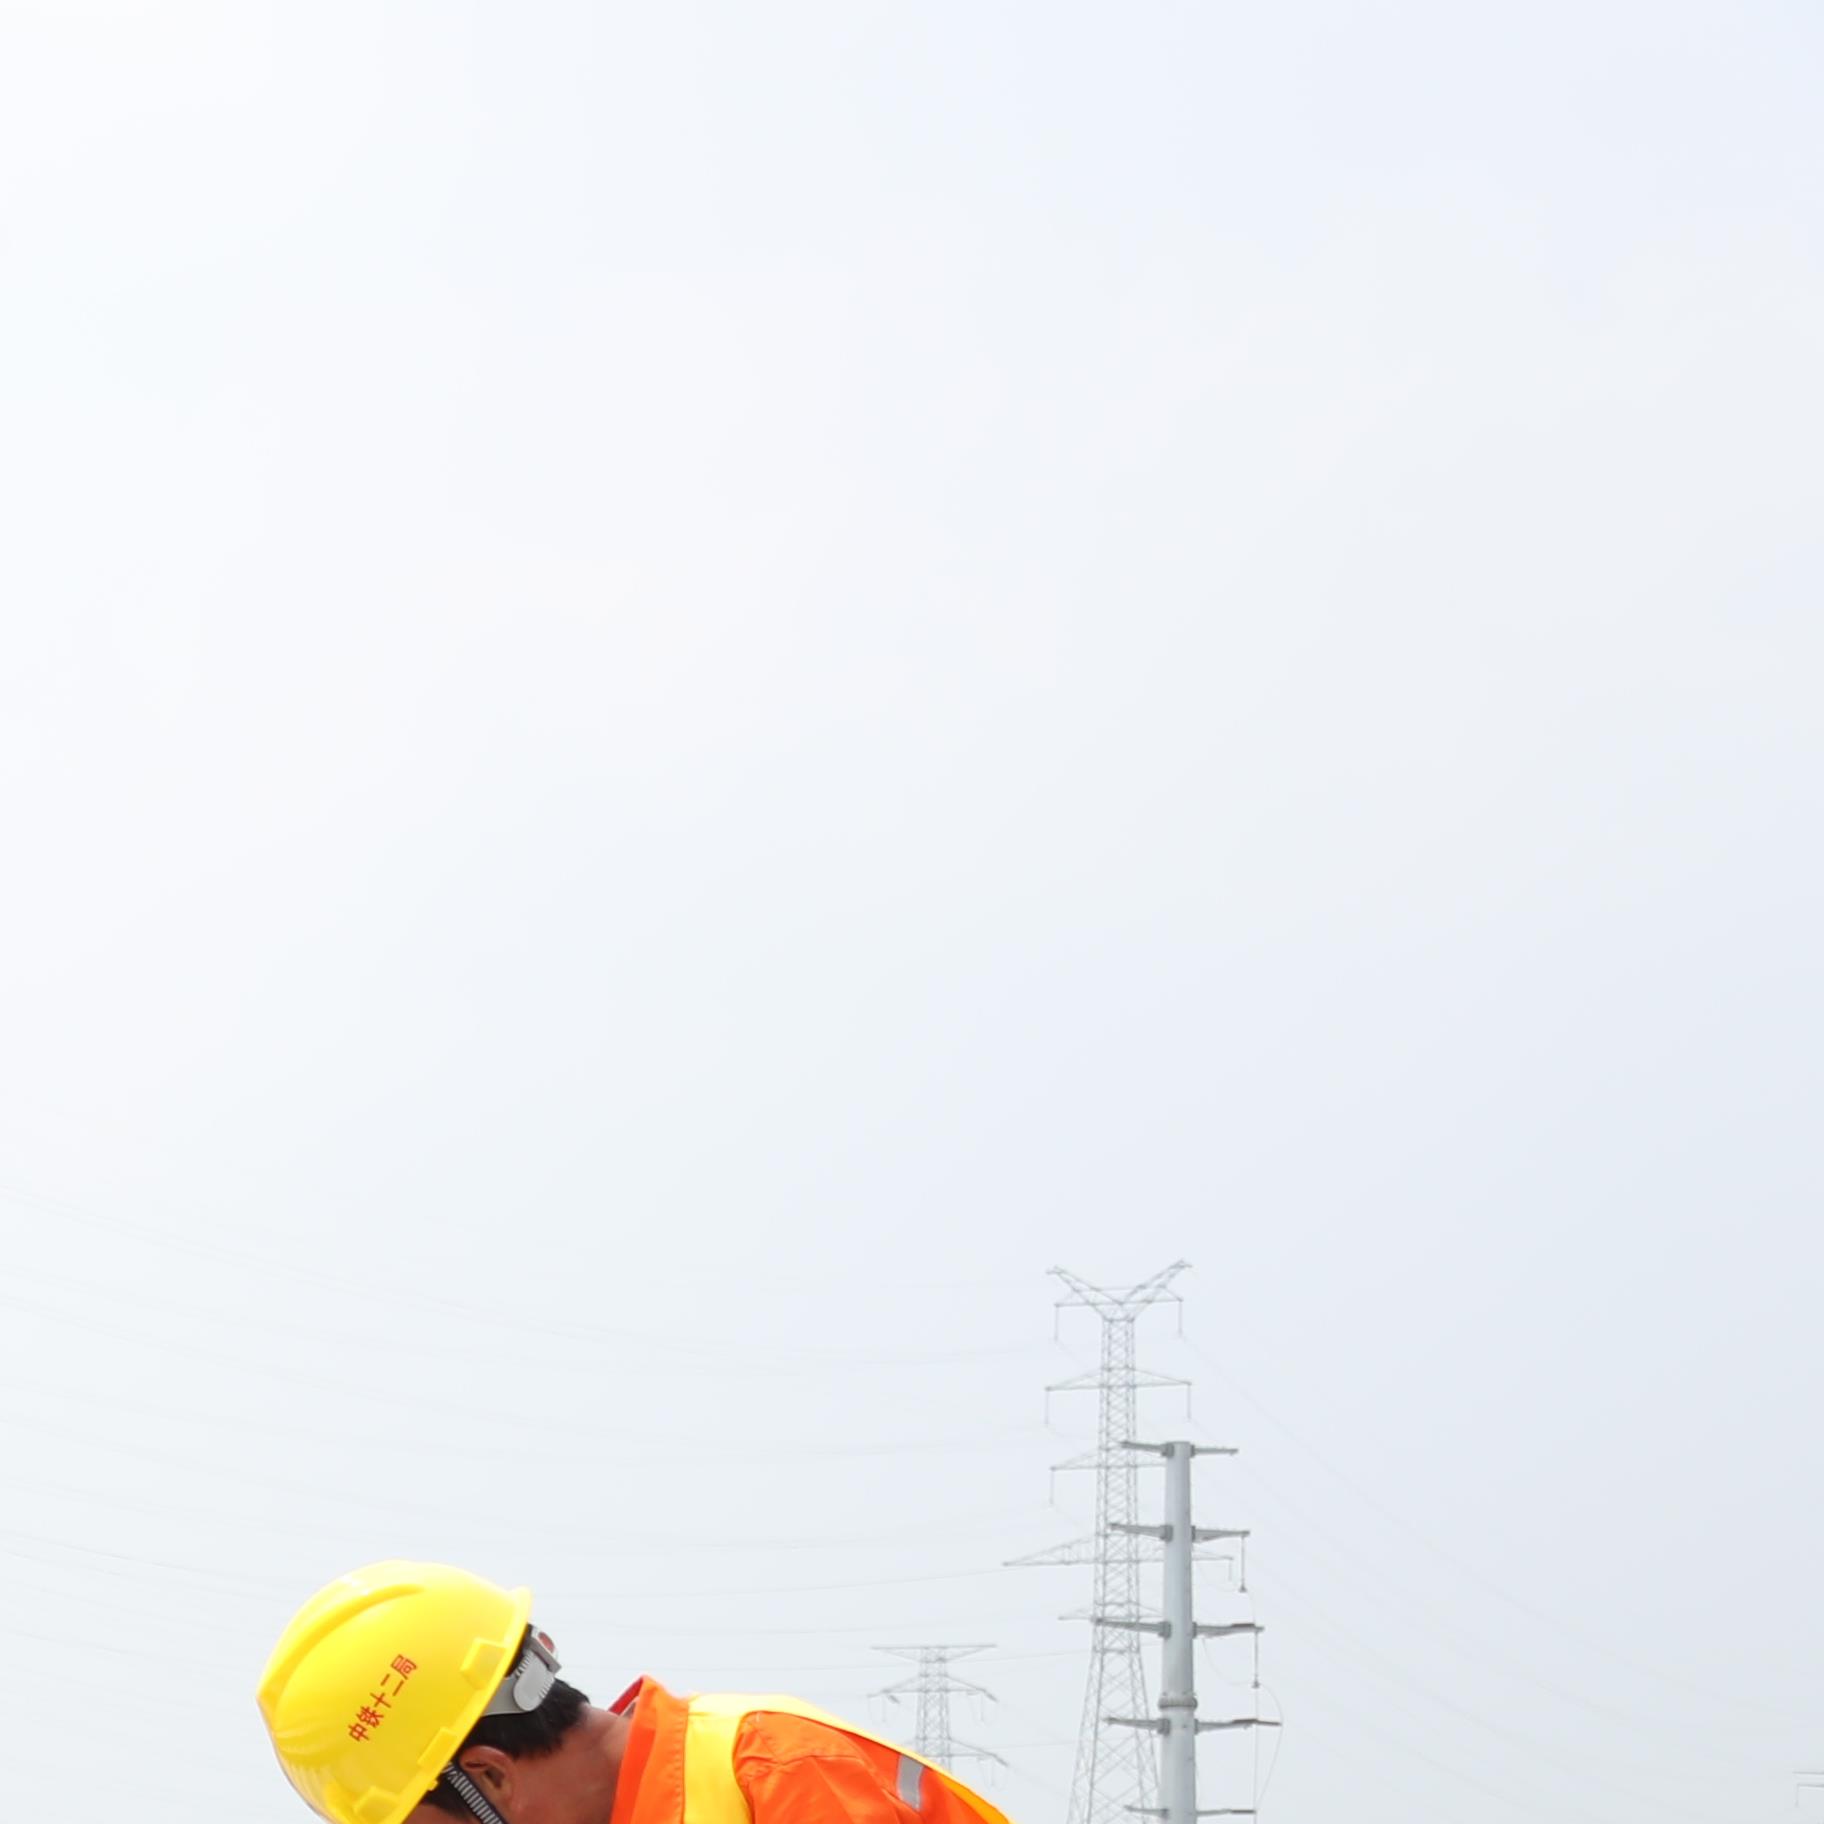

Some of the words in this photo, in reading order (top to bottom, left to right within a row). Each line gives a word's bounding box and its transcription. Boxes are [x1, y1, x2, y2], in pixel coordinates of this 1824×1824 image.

[347, 1653, 418, 1742] 中铁十二局
